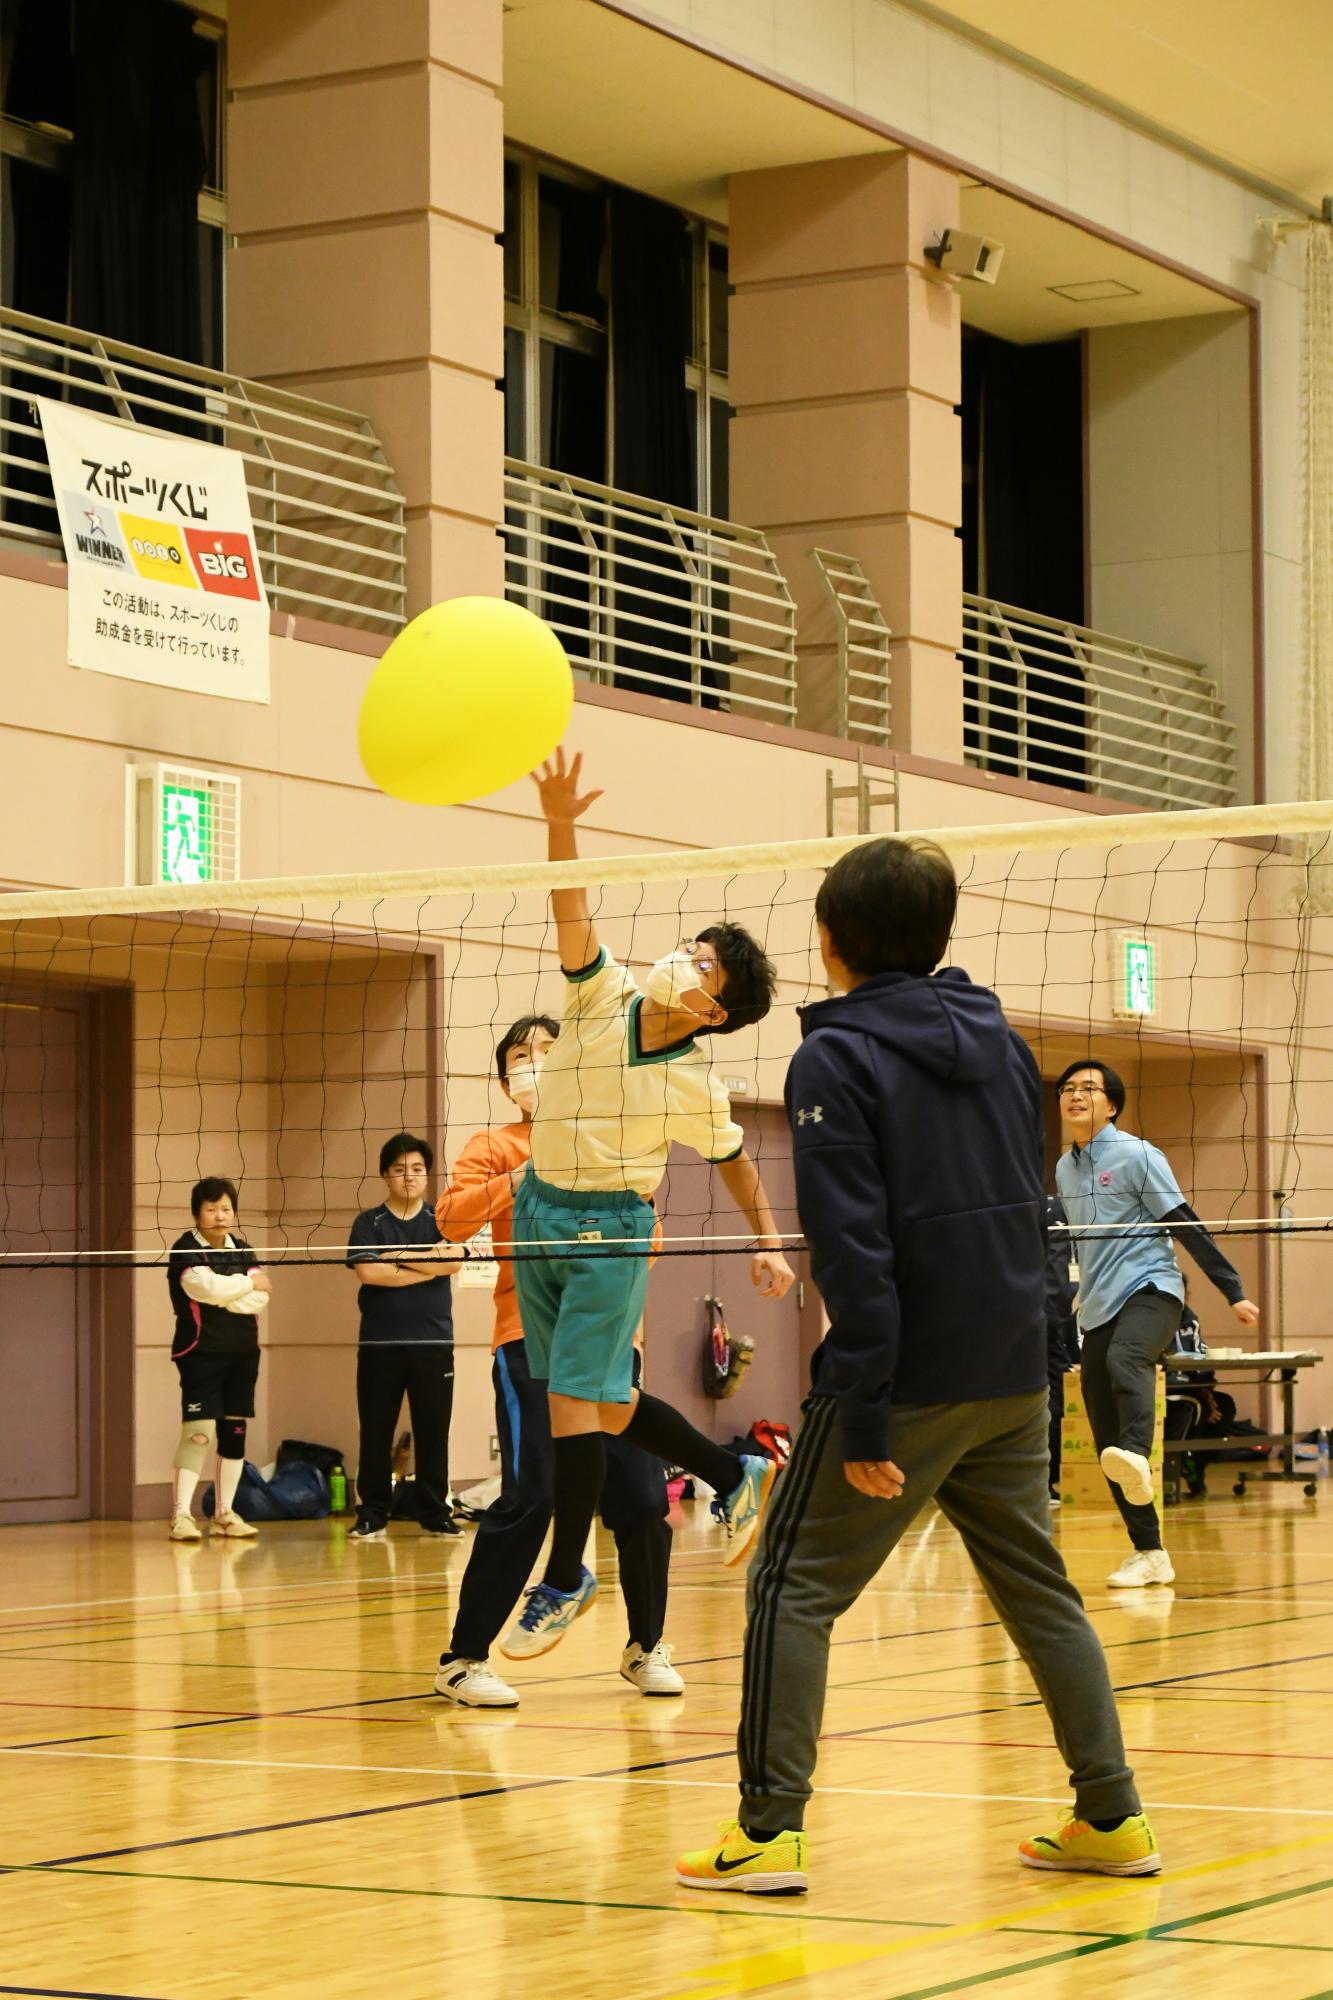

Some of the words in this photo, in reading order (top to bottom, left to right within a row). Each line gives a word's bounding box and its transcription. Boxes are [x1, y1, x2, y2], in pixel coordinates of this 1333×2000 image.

[81, 458, 207, 521] スポーツくじ
[76, 533, 126, 564] WINNER
[198, 549, 249, 580] BIG
